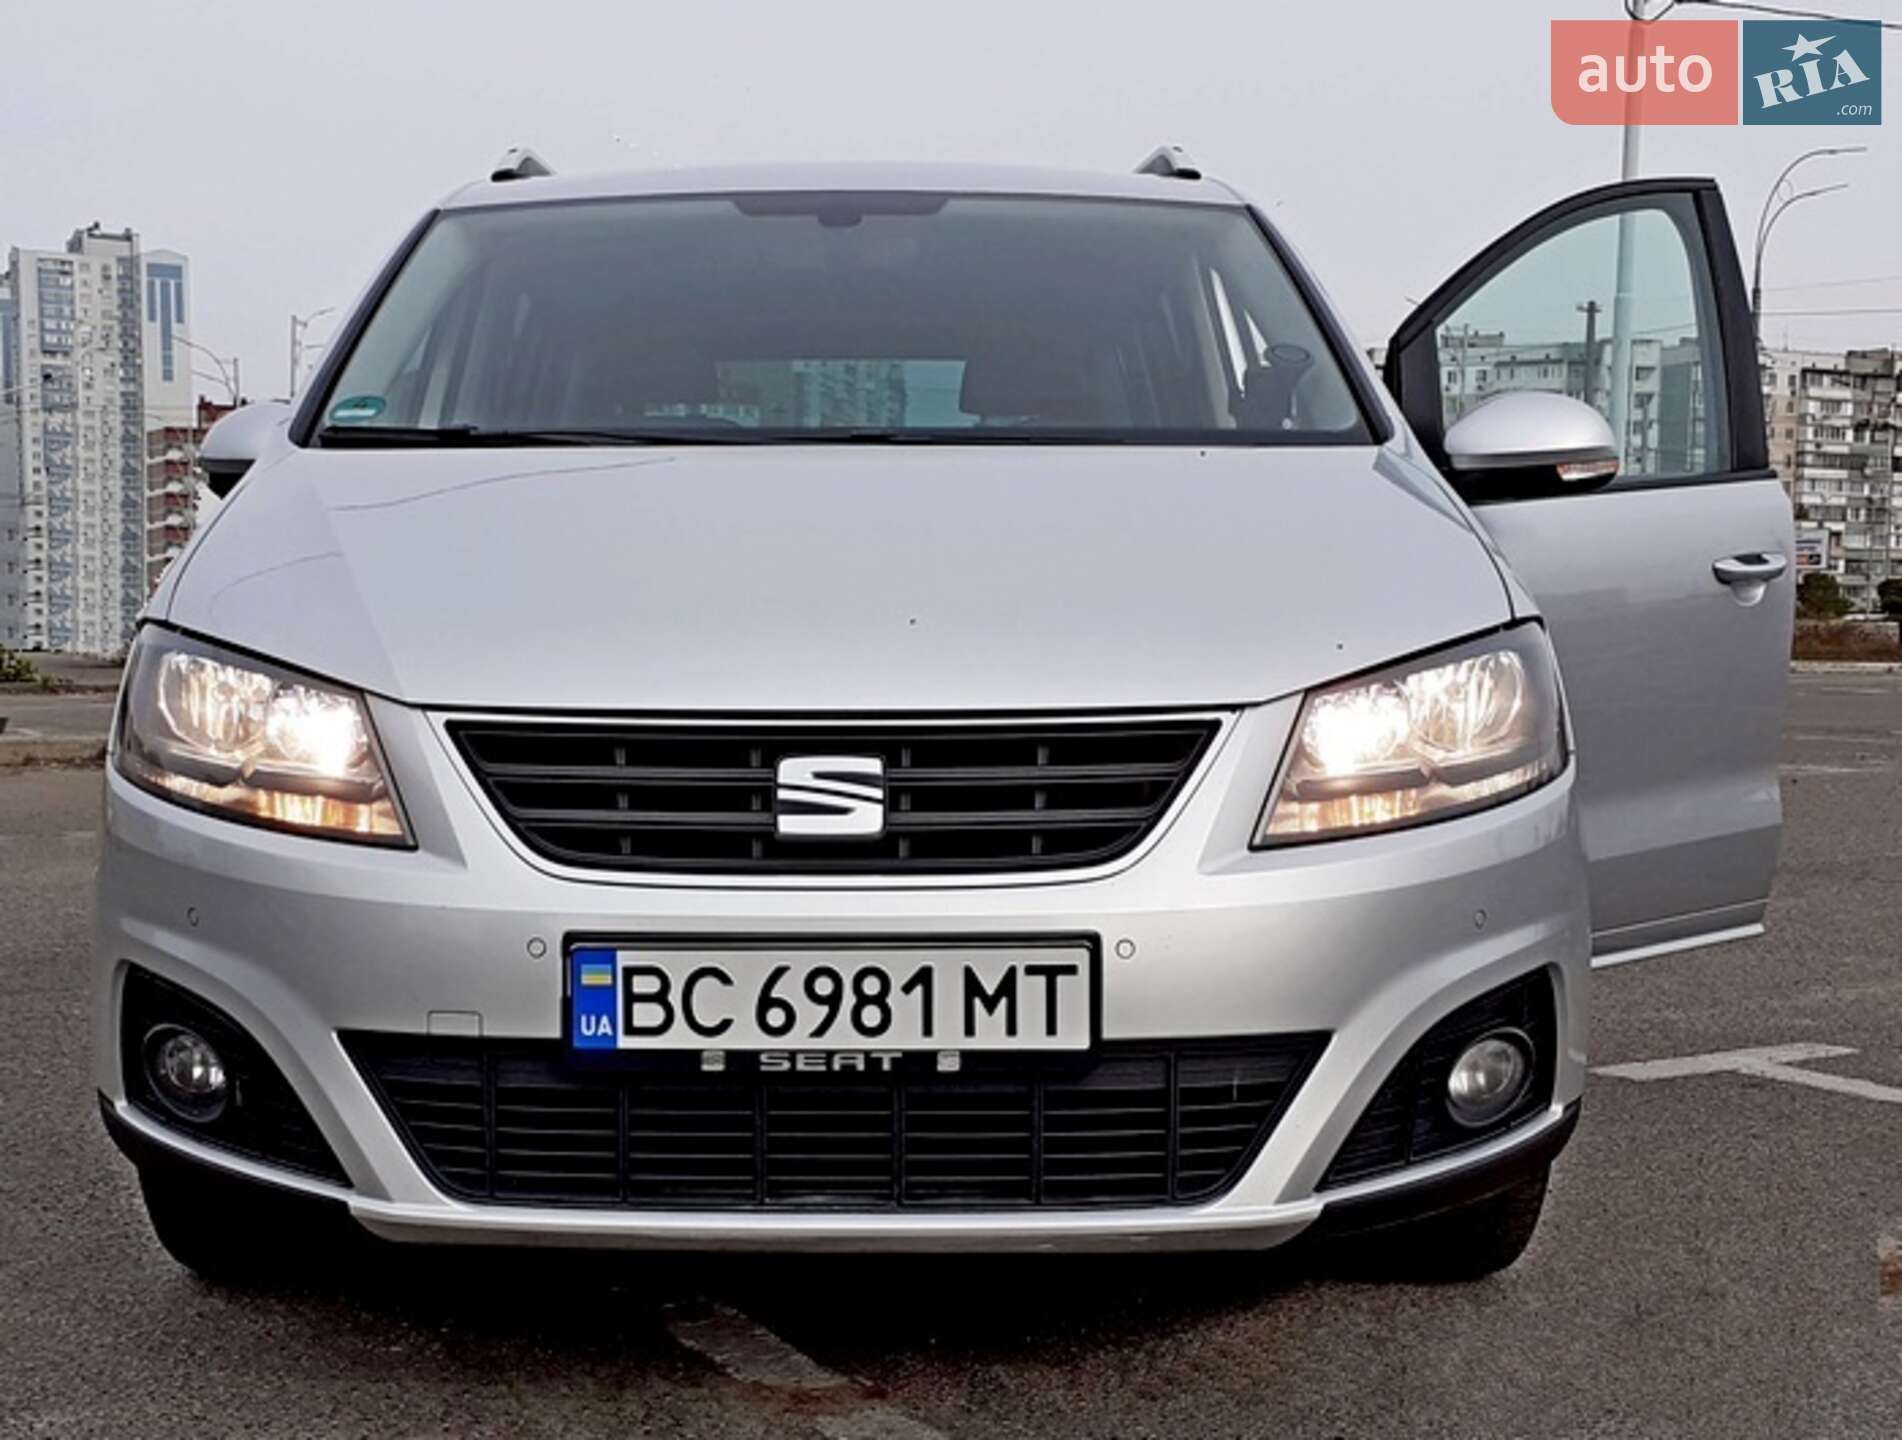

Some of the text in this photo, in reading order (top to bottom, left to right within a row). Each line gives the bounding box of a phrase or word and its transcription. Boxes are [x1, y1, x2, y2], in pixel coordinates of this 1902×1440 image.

[621, 964, 1079, 1038] BC 6981 MT
[580, 1015, 613, 1036] UA
[759, 1052, 903, 1072] SEAT
